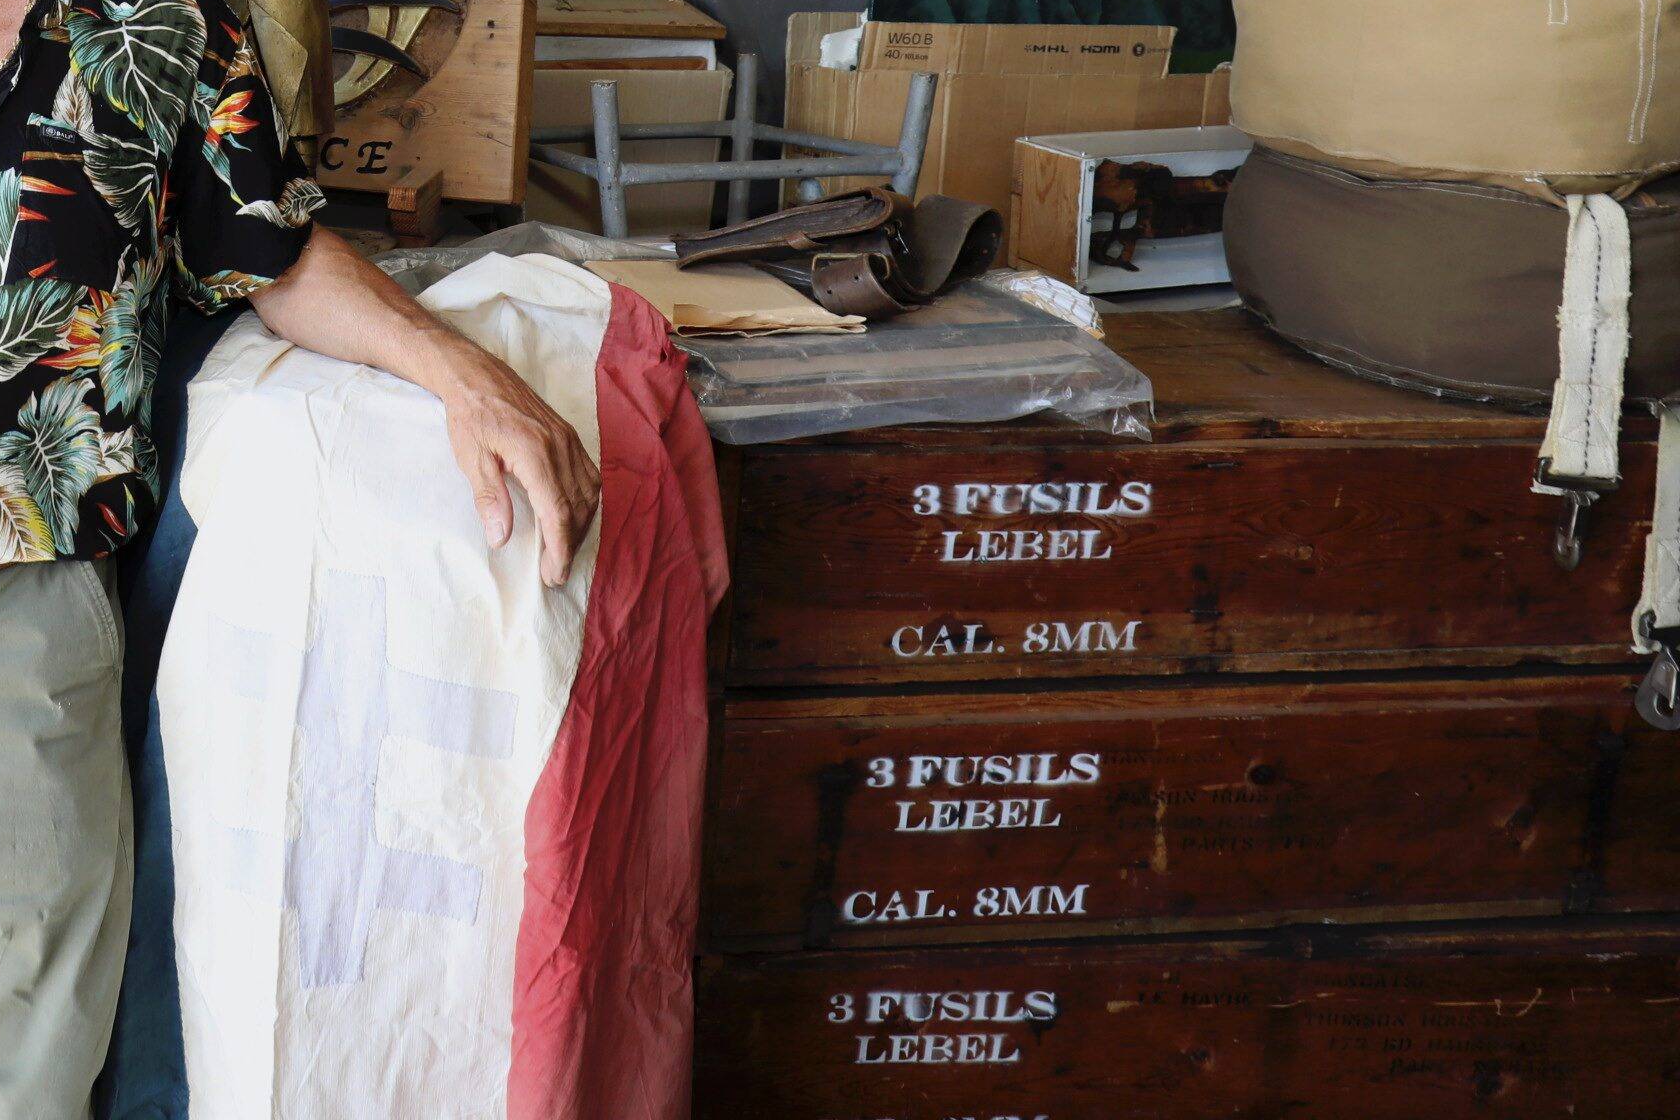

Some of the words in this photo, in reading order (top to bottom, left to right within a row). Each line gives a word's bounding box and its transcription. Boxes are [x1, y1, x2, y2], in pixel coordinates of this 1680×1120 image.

[1032, 43, 1071, 54] MHL
[1080, 43, 1121, 54] HDMI
[912, 483, 943, 517] 3
[952, 480, 1154, 518] FUSILS
[939, 528, 1114, 564] LEBEL
[889, 623, 1006, 659] CAL.
[1021, 619, 1143, 654] 8MM
[866, 756, 897, 790] 3
[905, 752, 1102, 789] FUSILS
[893, 797, 1062, 834] LEBEL
[842, 887, 958, 925] CAL.
[972, 883, 1091, 919] 8MM
[827, 993, 855, 1024] 3
[866, 989, 1057, 1024] FUSILS
[854, 1032, 1021, 1064] LEBEL
